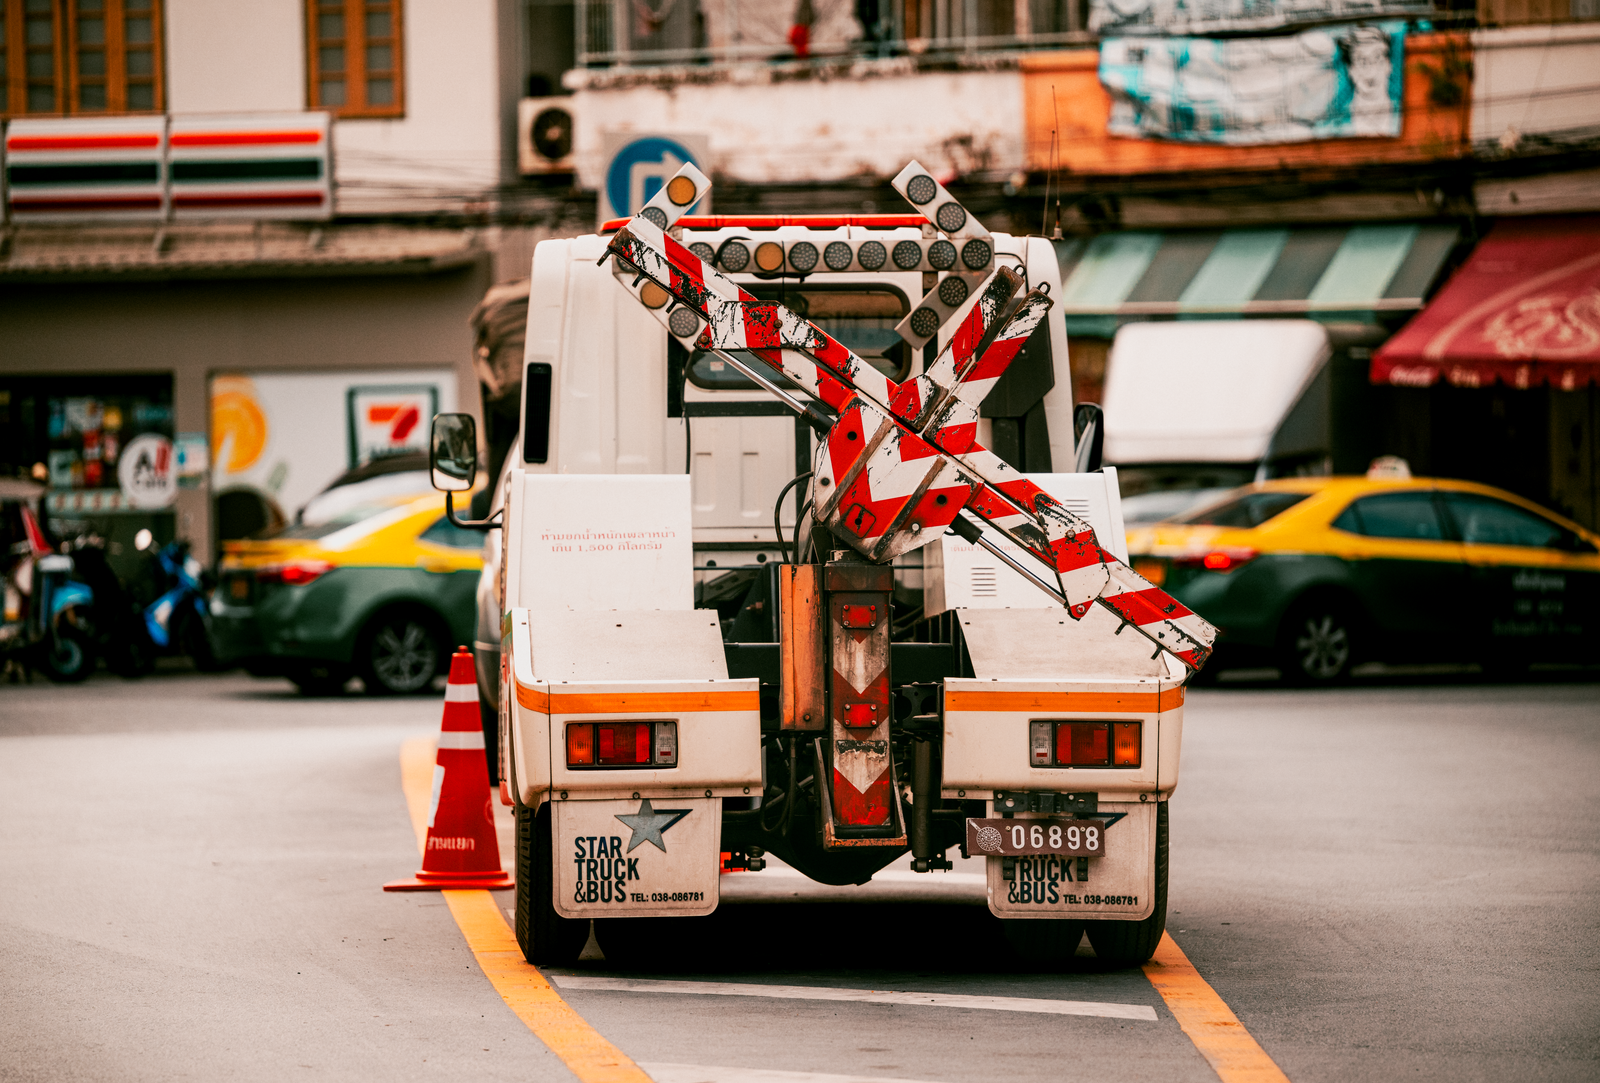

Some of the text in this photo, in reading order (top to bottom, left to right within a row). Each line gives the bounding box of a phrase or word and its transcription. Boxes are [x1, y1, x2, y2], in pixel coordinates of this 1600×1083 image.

[541, 526, 676, 541] ห้ามยกน้ำหนักเพลาหน้า
[551, 542, 572, 552] เกิน
[618, 541, 663, 551] กิโลกรัม
[574, 836, 623, 859] STAR
[1011, 825, 1099, 851] 06898
[574, 858, 640, 881] TRUCK
[574, 880, 704, 903] &BUS TEL: 038-086781
[1008, 881, 1138, 906] &BUS TEL: 038-086781
